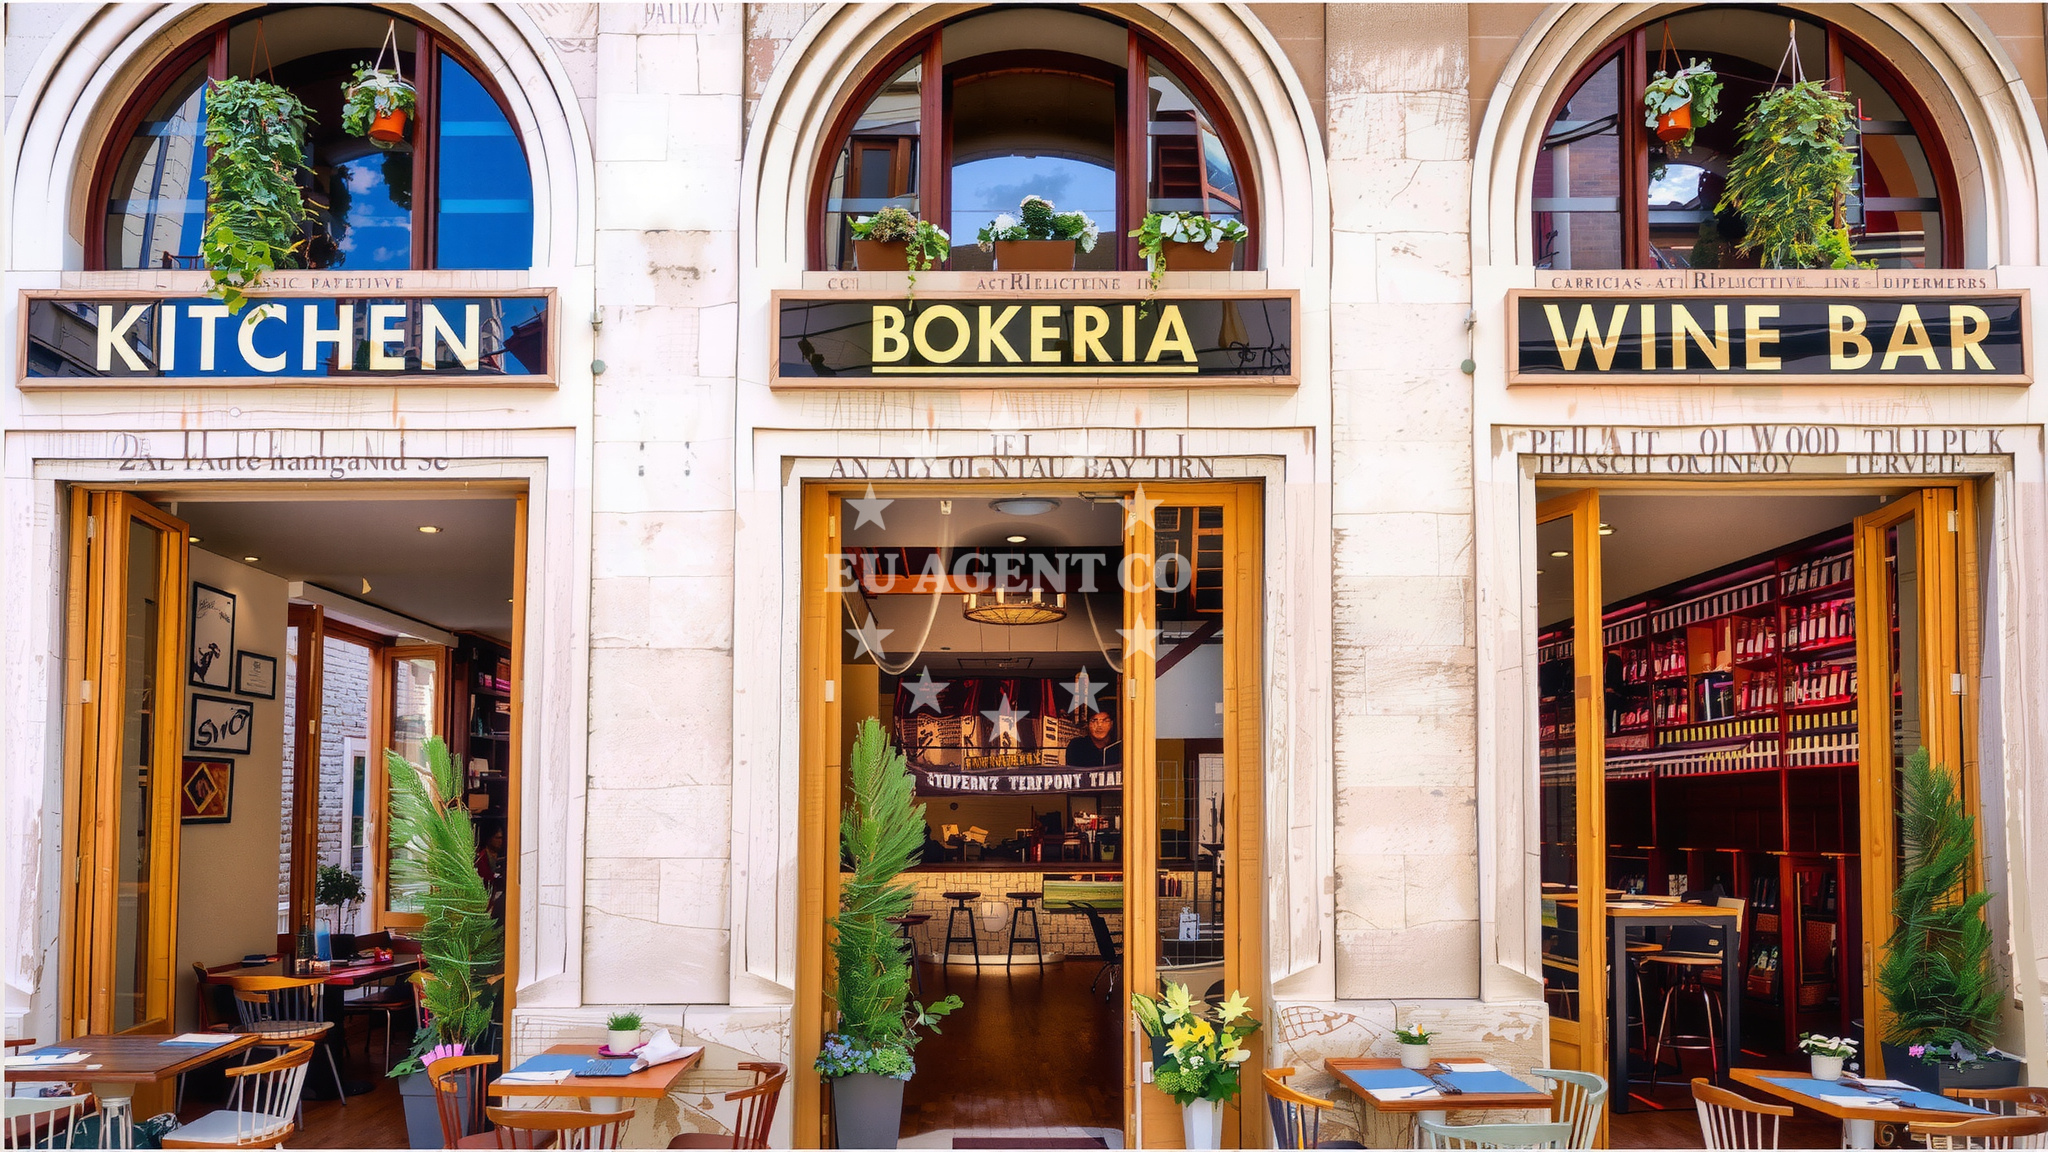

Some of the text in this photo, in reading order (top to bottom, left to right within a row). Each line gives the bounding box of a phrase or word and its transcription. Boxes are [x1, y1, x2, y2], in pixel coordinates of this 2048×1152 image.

[97, 304, 480, 372] KITCHEN
[872, 304, 1198, 364] BOKERIA
[1543, 304, 1996, 371] WINE BAR
